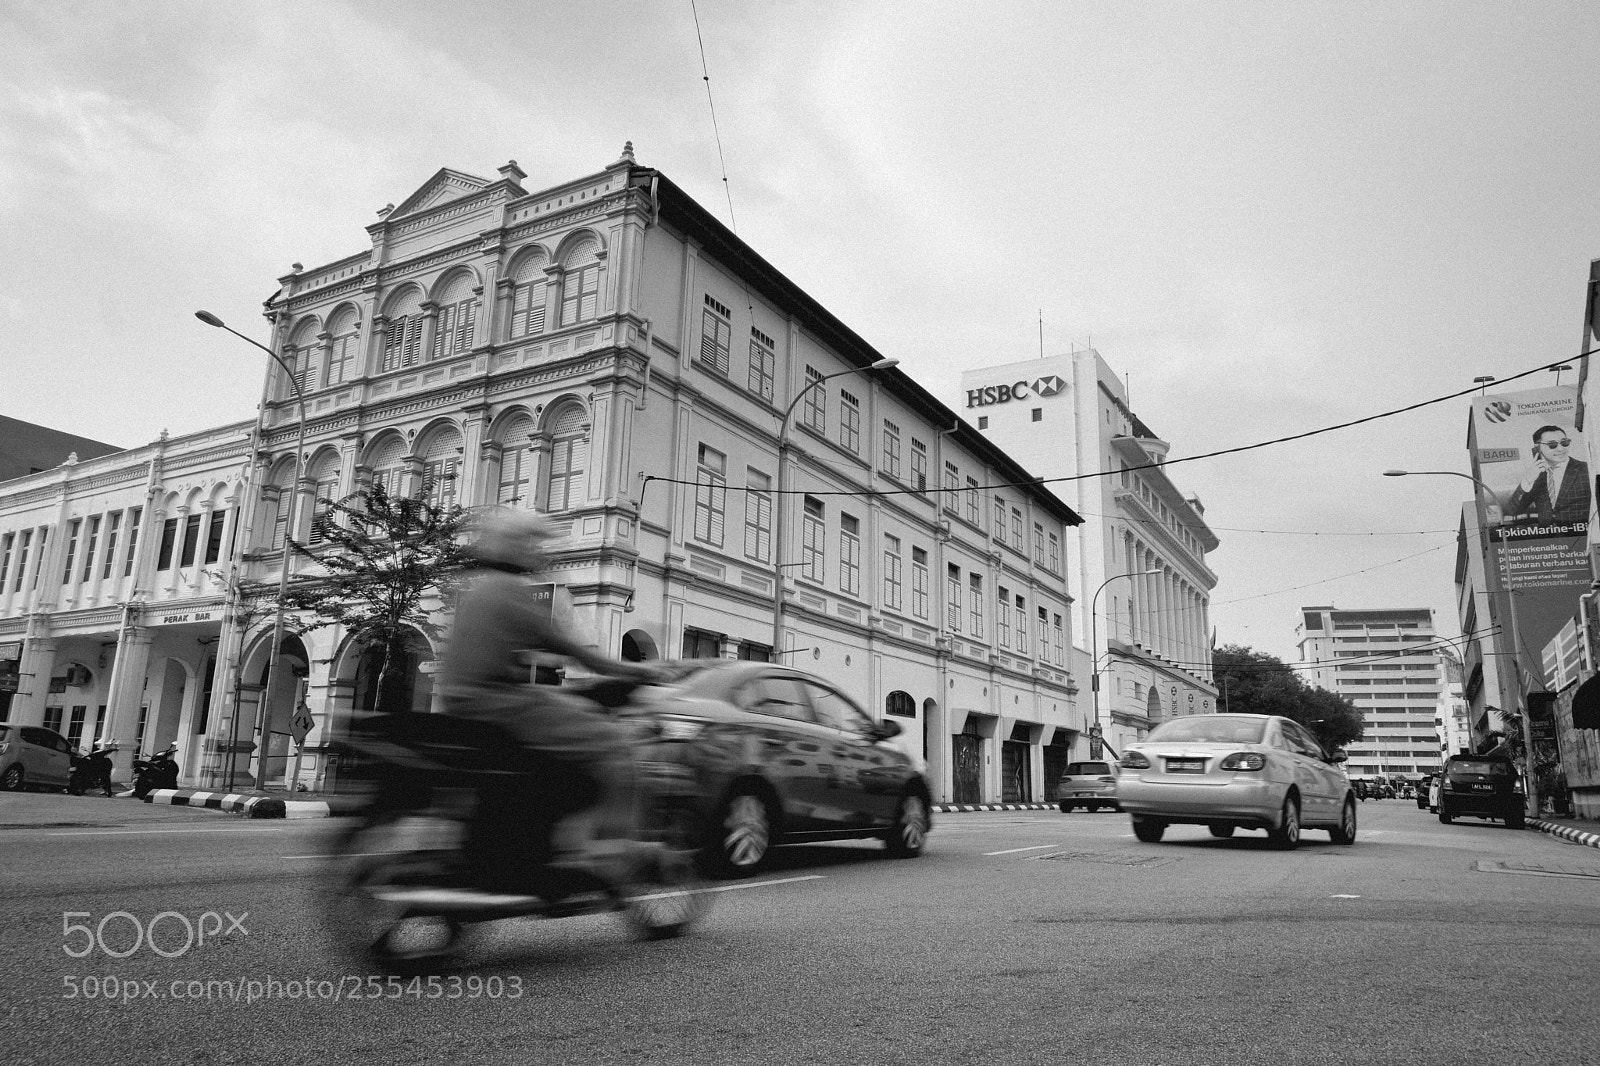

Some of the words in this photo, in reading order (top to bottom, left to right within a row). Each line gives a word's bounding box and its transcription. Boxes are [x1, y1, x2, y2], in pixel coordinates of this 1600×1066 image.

[966, 380, 1028, 408] HSBC
[1541, 399, 1572, 407] MARINE
[1499, 555, 1521, 563] plan
[1523, 553, 1558, 561] insurans
[1500, 561, 1540, 571] plaburan
[1542, 559, 1573, 568] terbaru
[1502, 578, 1590, 589] ww.tokiomarine.com
[164, 615, 189, 623] PERAK
